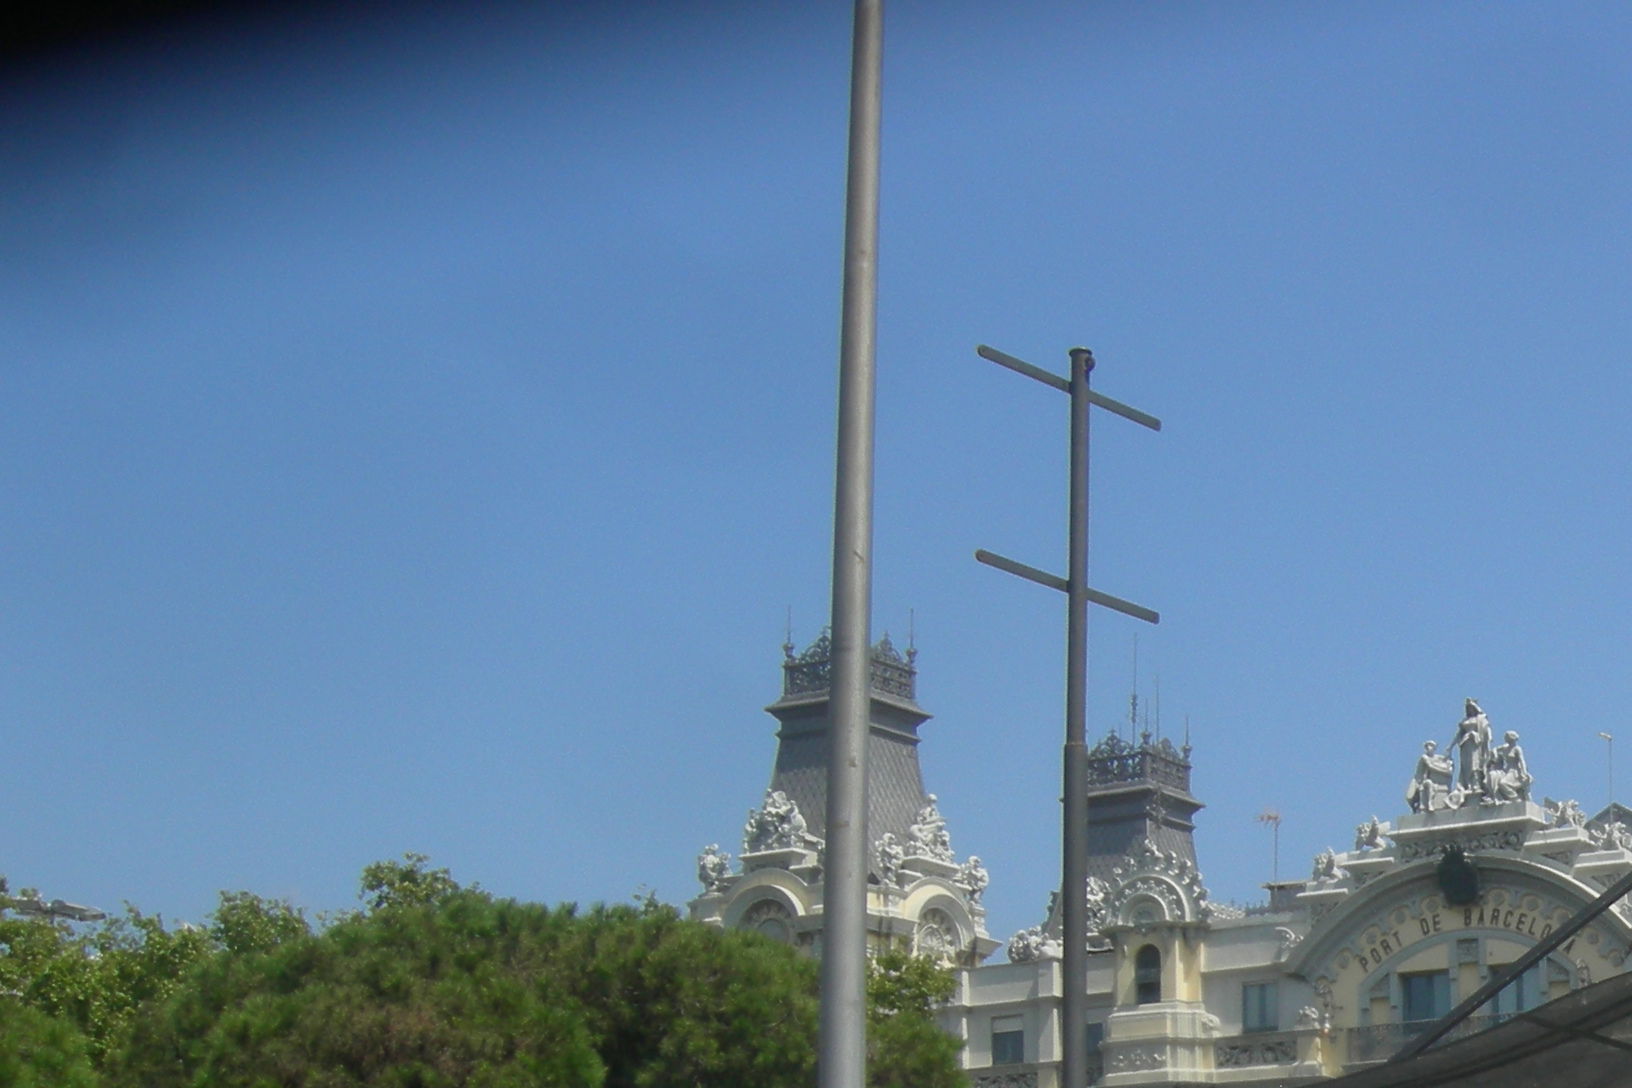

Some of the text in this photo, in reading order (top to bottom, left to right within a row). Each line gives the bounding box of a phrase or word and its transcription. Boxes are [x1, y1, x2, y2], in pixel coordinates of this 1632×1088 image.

[1358, 908, 1576, 973] PORT DE BARCELOA
